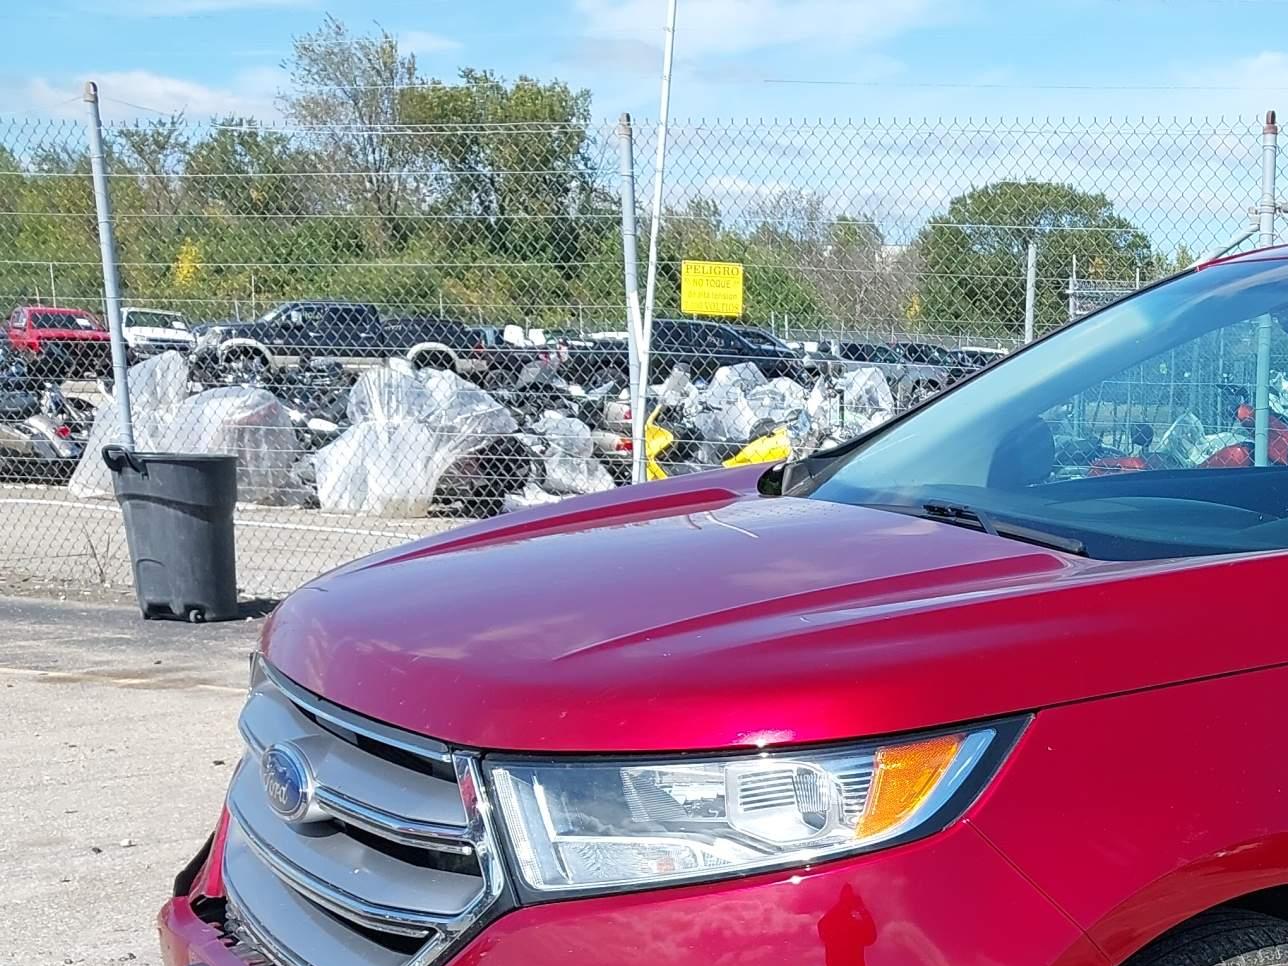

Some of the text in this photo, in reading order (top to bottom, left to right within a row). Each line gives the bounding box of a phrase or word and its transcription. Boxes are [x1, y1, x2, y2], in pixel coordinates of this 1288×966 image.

[684, 264, 740, 276] PELIGRO
[693, 278, 731, 289] NO TOQUE
